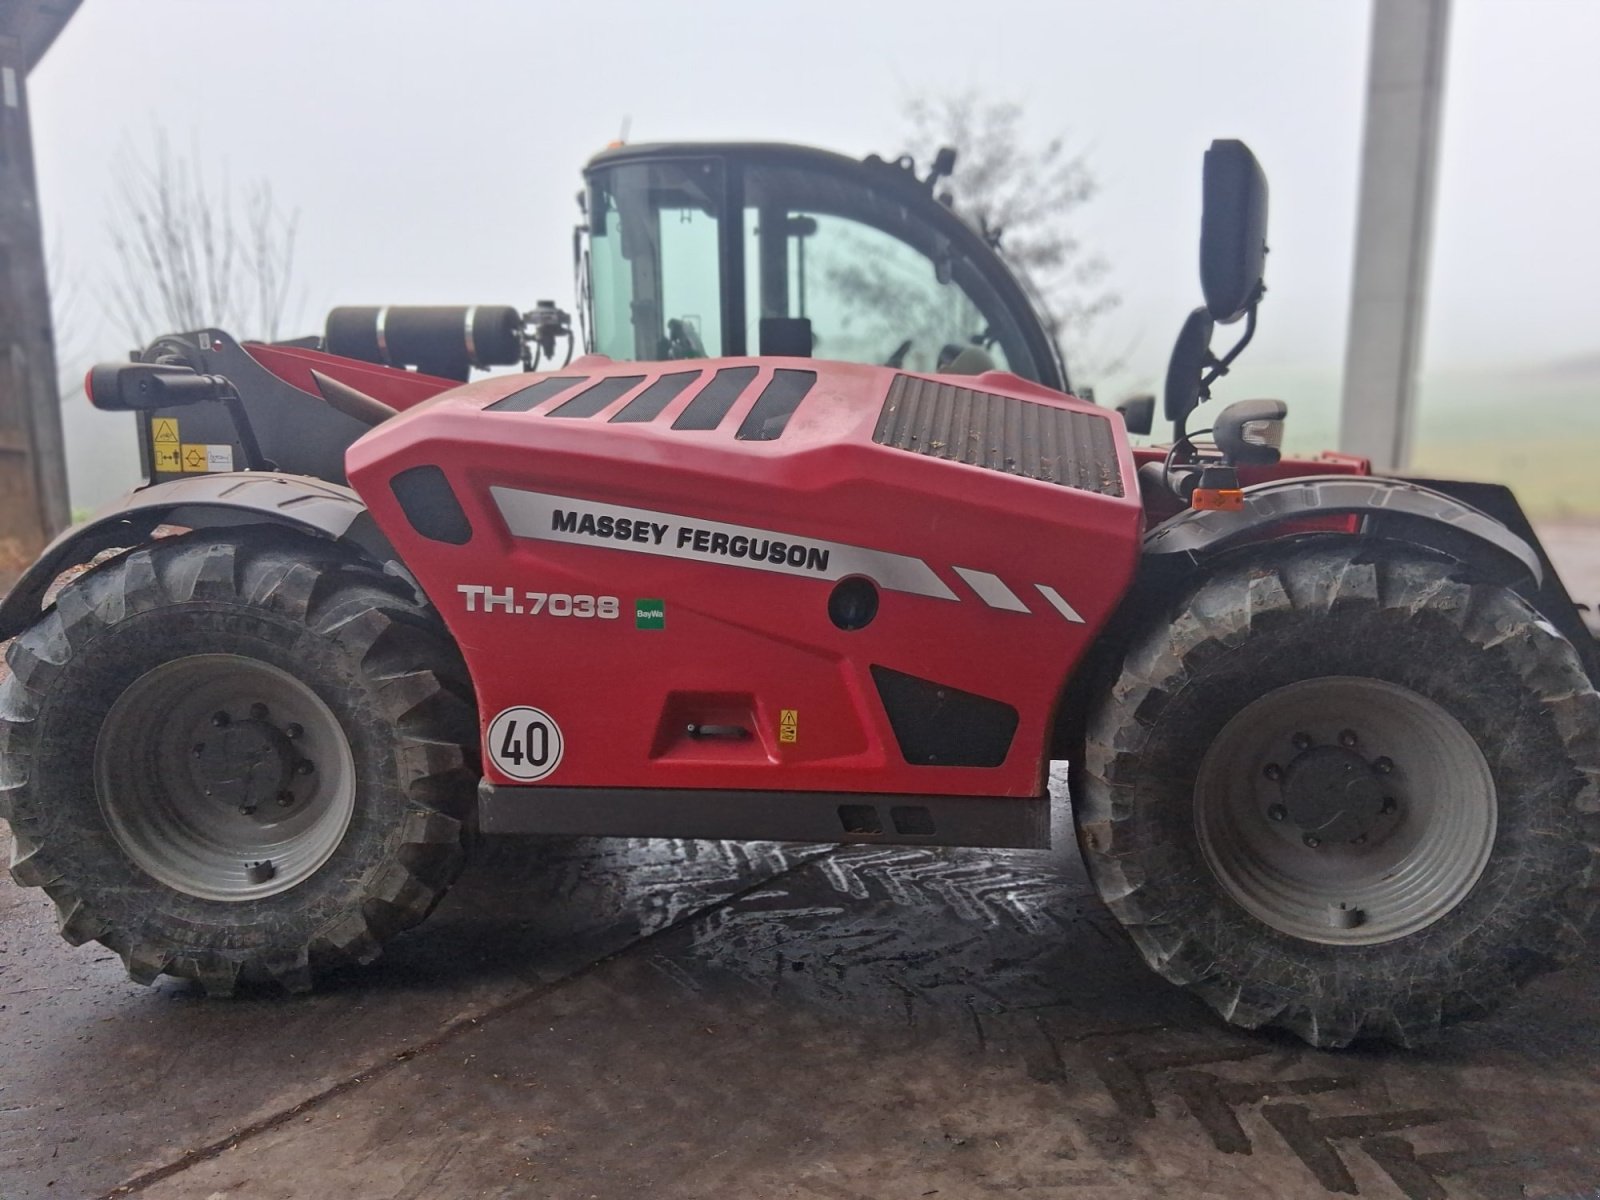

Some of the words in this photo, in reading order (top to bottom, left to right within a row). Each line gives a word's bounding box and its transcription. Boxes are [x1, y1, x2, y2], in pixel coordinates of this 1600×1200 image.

[552, 509, 668, 546] MASSEY
[677, 527, 829, 571] FERGUSON
[457, 585, 619, 619] TH.7038
[636, 610, 663, 619] BayWa
[500, 720, 549, 766] 40
